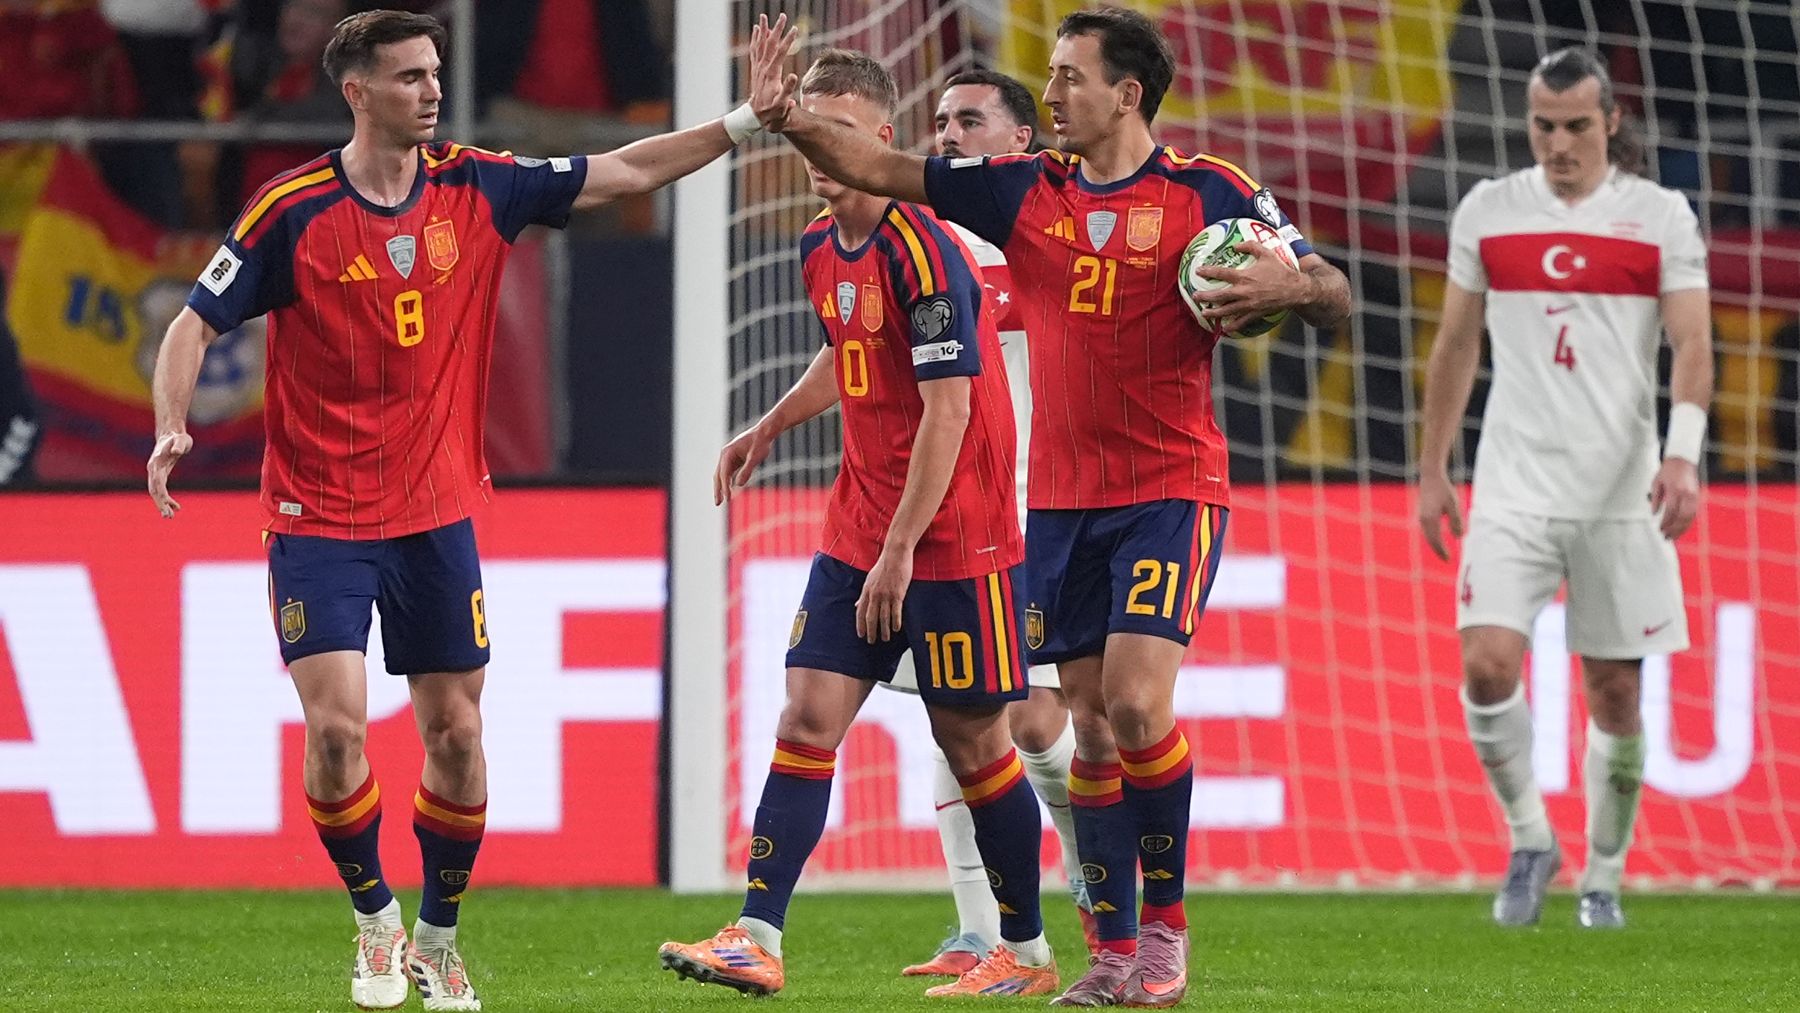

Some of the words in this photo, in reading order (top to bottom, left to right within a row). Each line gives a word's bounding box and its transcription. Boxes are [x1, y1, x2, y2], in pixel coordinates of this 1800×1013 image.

[1068, 255, 1117, 315] 21
[394, 290, 425, 347] 8
[1554, 324, 1576, 371] 4
[471, 588, 488, 649] 8
[1125, 559, 1181, 619] 21
[924, 631, 975, 690] 10
